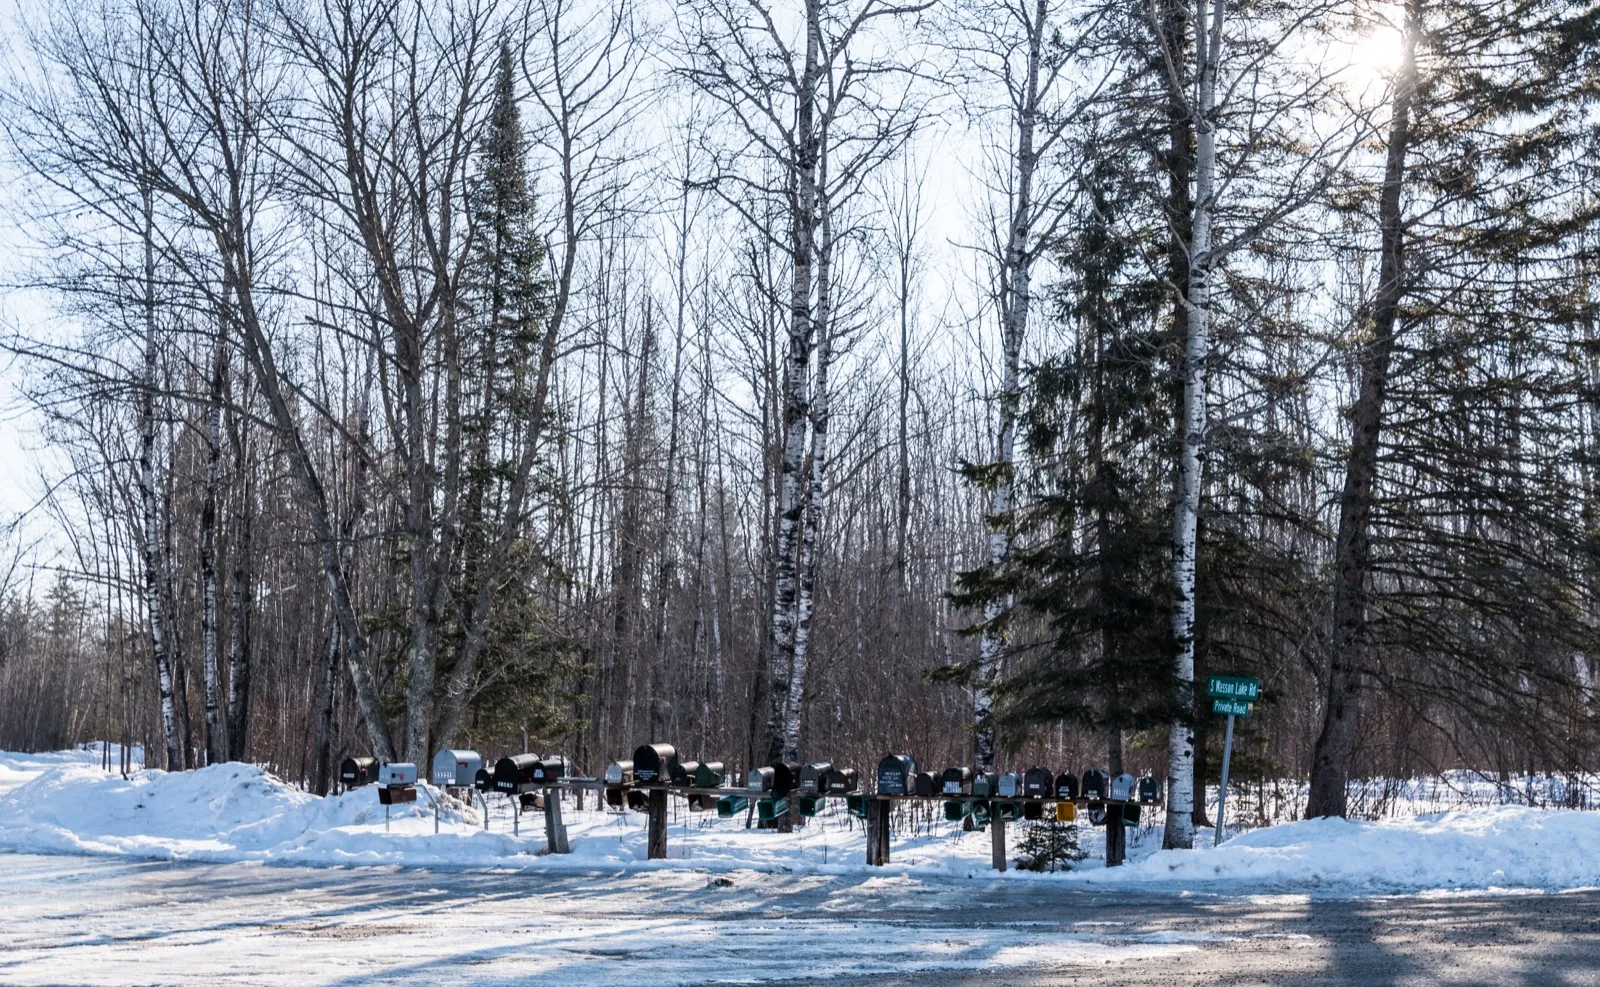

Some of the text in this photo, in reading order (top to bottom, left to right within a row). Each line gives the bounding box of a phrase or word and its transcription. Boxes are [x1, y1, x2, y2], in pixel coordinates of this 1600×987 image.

[1210, 679, 1215, 692] S
[1235, 681, 1248, 695] Lake
[1249, 683, 1257, 696] Rd
[1214, 700, 1247, 714] Private Road
